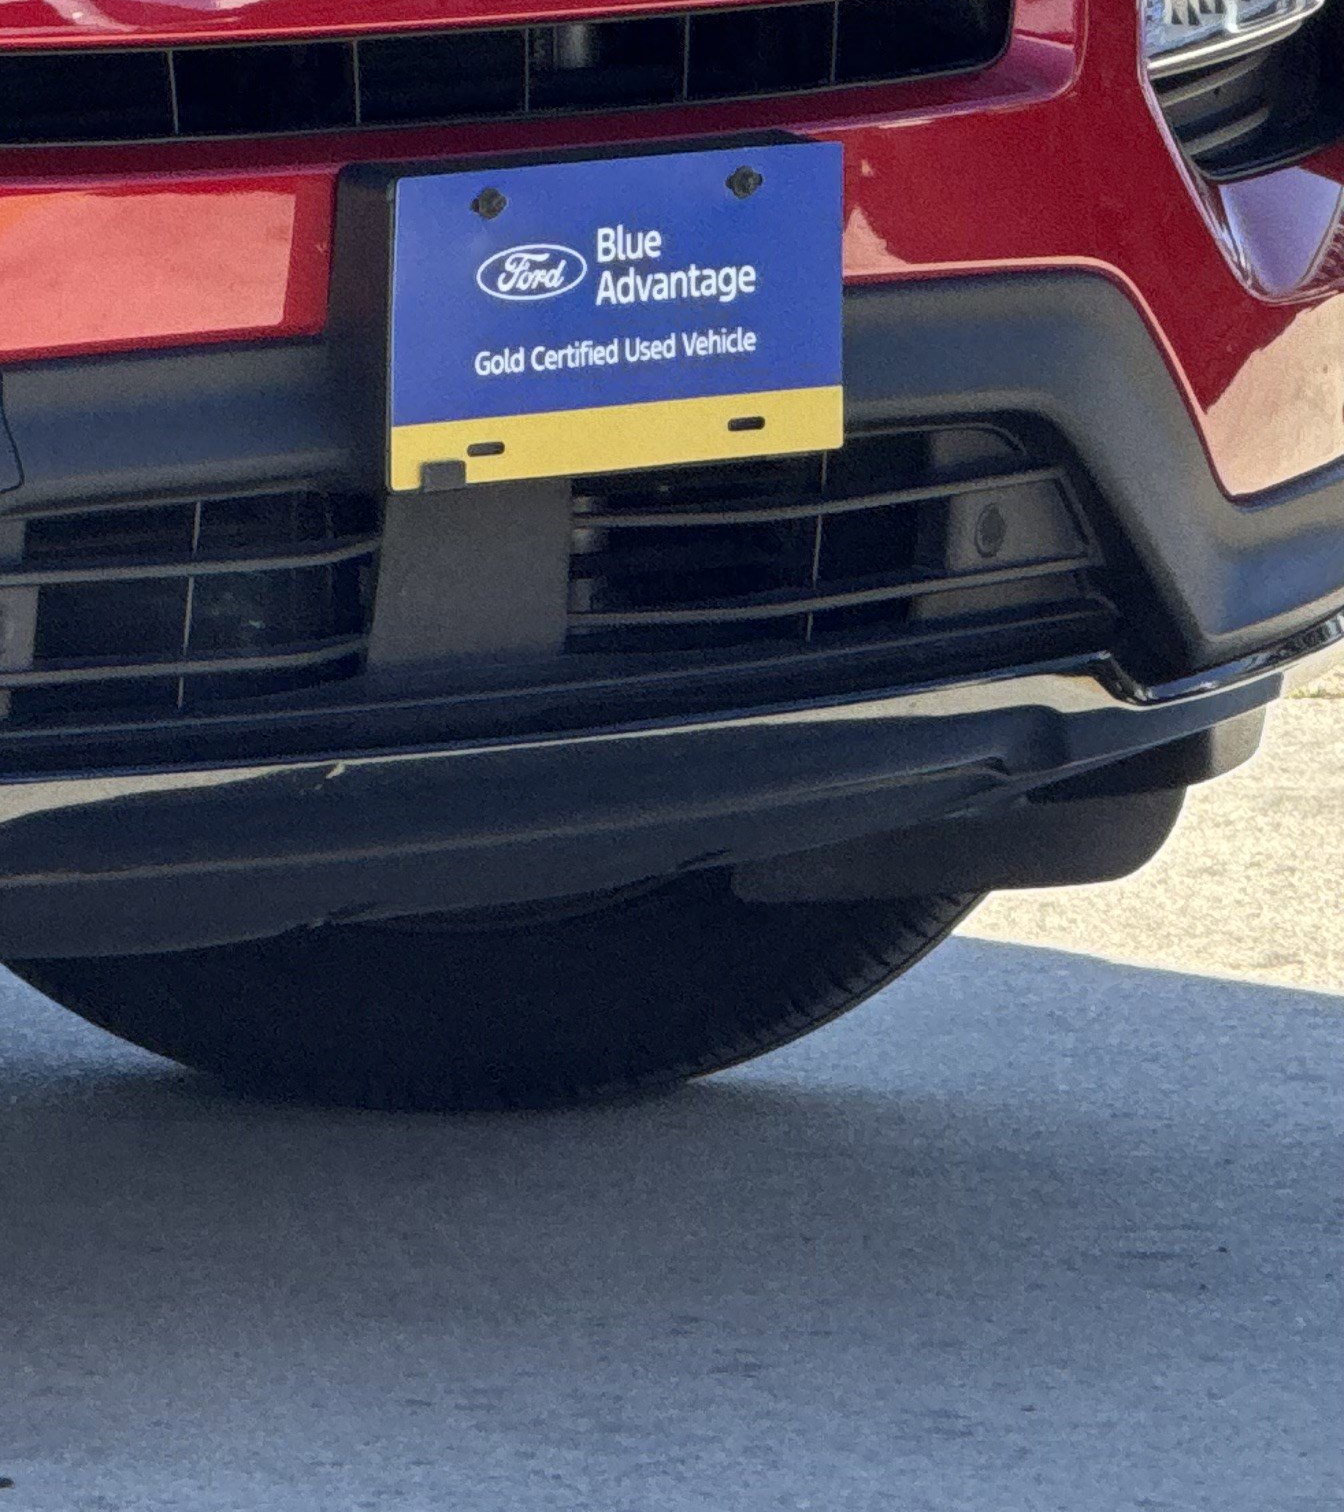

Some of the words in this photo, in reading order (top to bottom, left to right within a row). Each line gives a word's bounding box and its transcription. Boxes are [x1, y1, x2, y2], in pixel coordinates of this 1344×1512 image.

[597, 227, 662, 262] Blue
[497, 253, 565, 292] Ford
[595, 264, 755, 306] Advantage
[474, 348, 525, 376] Gold
[530, 339, 618, 370] Certified
[624, 334, 676, 362] Used
[681, 326, 757, 356] Vehicle
